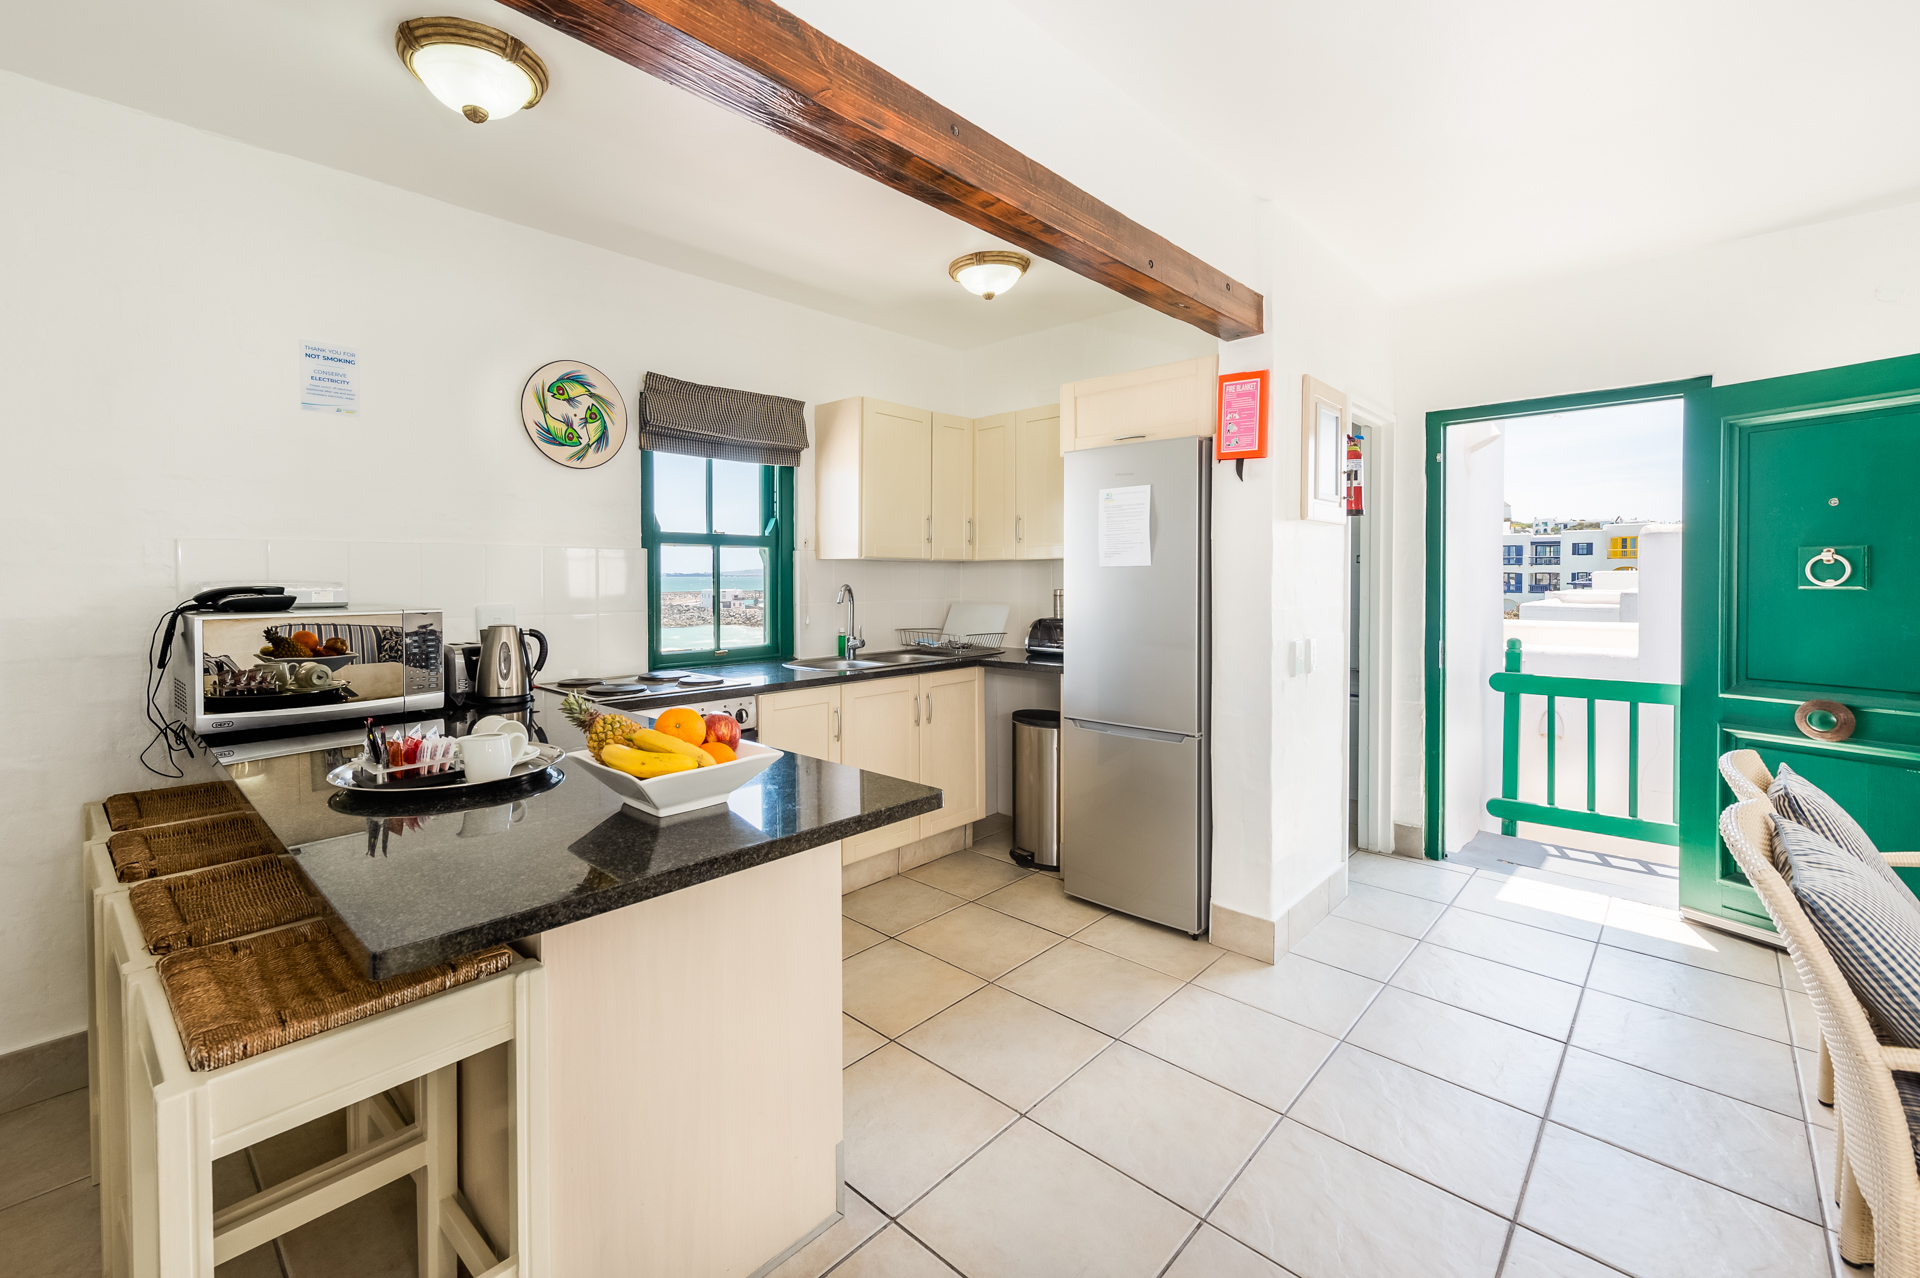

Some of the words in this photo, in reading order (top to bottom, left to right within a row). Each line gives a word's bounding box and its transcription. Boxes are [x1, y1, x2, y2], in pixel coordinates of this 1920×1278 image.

[304, 345, 326, 353] THANK
[322, 356, 356, 366] SMOKING
[313, 369, 347, 378] CONSERVE
[310, 376, 350, 385] ELECTRICITY
[1236, 382, 1256, 391] BLANKET
